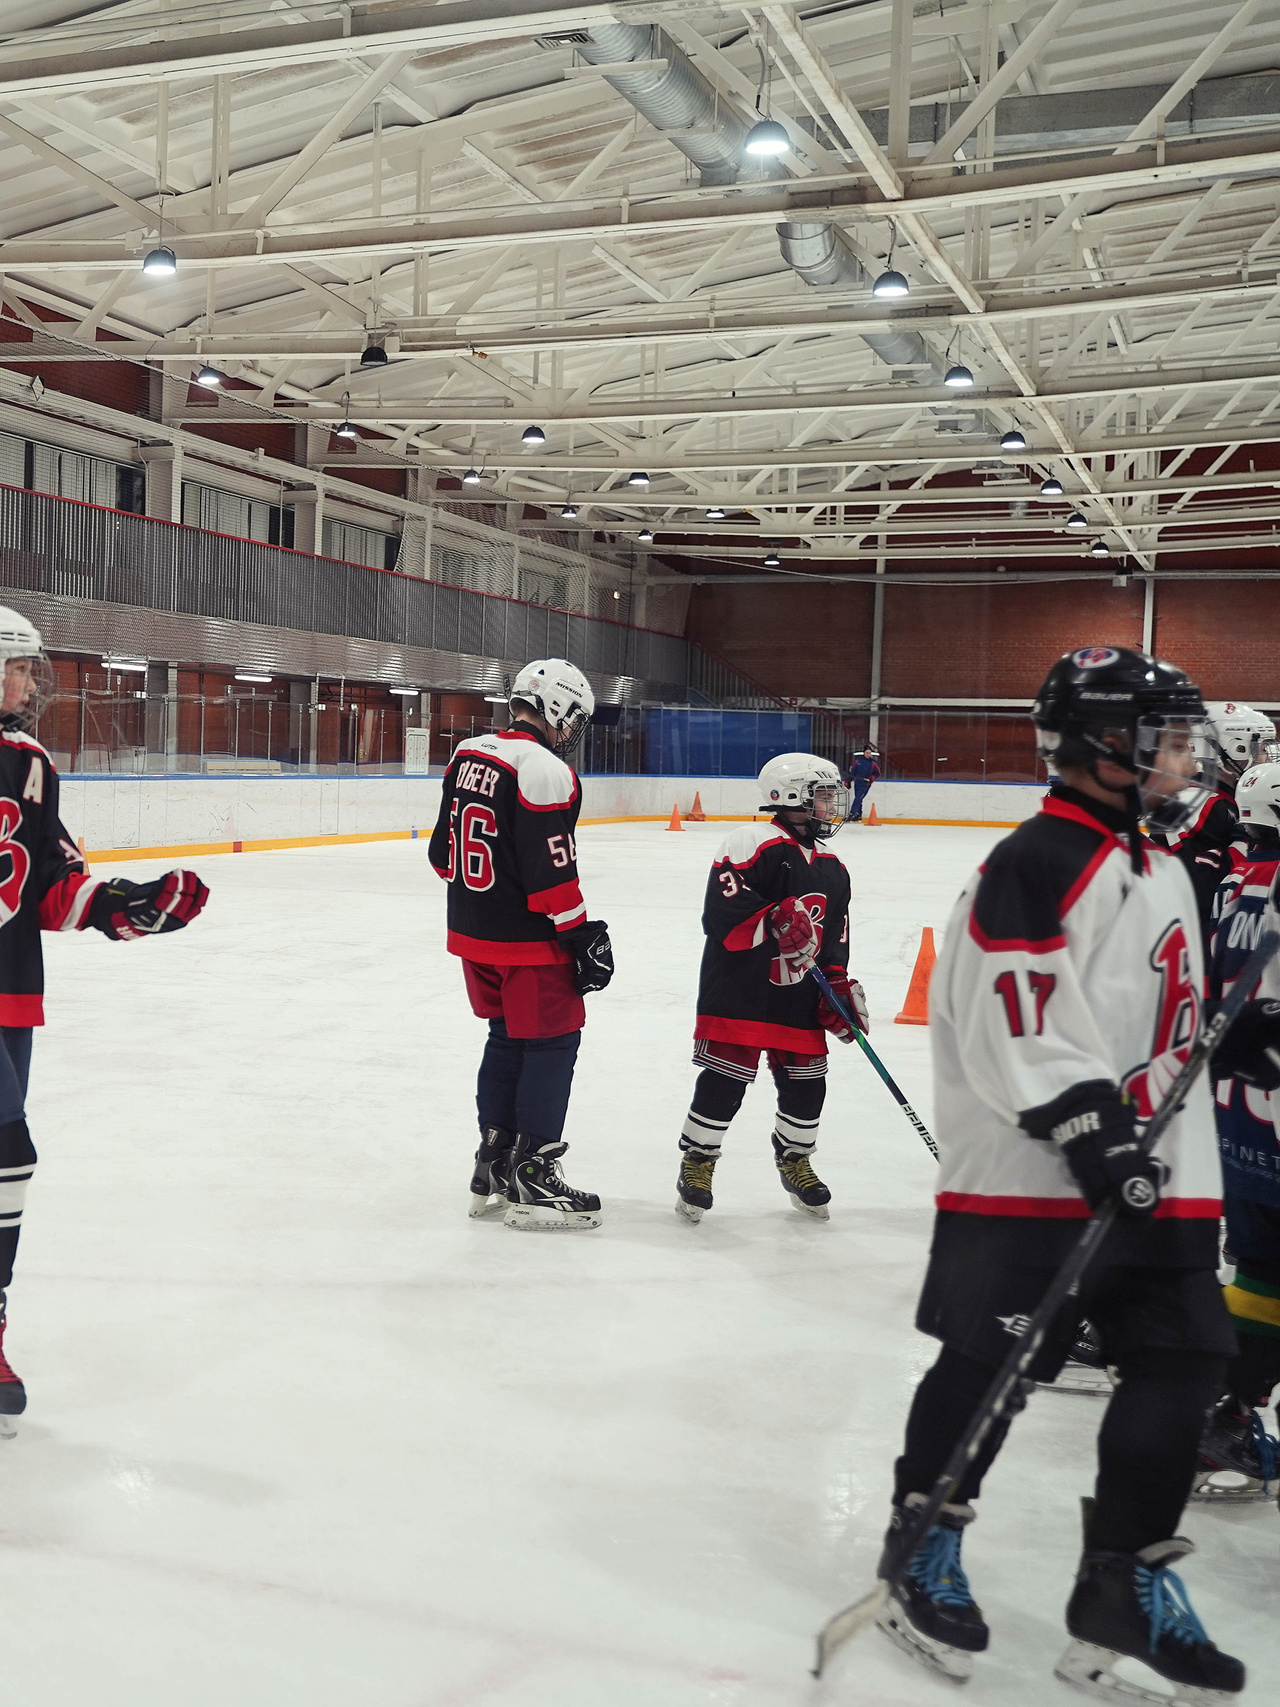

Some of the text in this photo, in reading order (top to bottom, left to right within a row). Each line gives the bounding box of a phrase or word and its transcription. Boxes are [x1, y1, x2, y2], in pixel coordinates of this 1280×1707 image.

[555, 681, 583, 698] MISSION
[1079, 692, 1134, 701] BAUER
[22, 756, 44, 805] A
[993, 969, 1058, 1038] 17
